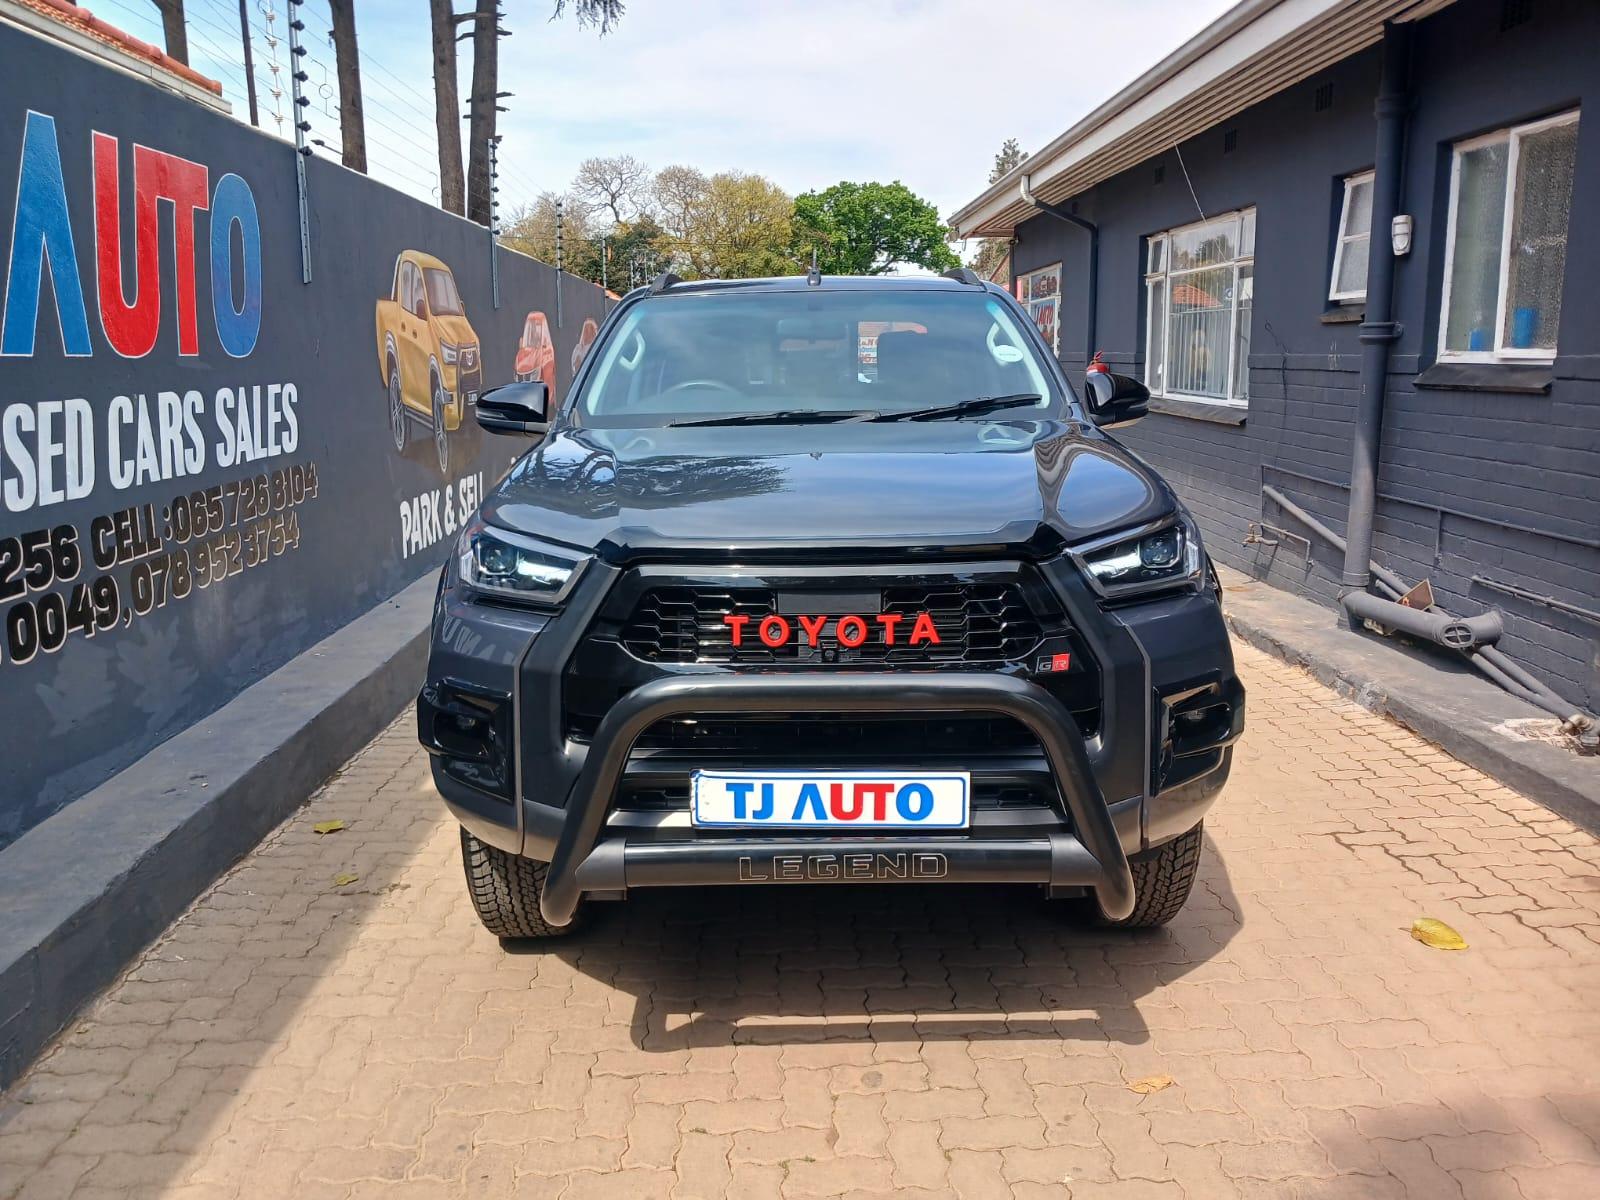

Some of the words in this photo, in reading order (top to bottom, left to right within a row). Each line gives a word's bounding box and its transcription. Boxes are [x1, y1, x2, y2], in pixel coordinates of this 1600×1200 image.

[0, 109, 262, 358] AUTO
[108, 390, 205, 490] CARS
[215, 383, 298, 468] SALES
[400, 489, 442, 559] PARK
[445, 484, 457, 536] &
[0, 525, 82, 602] 256
[724, 614, 941, 648] TOYOTA
[726, 783, 774, 820] TJ
[791, 783, 934, 821] AUTO
[738, 852, 949, 881] LEGEND
